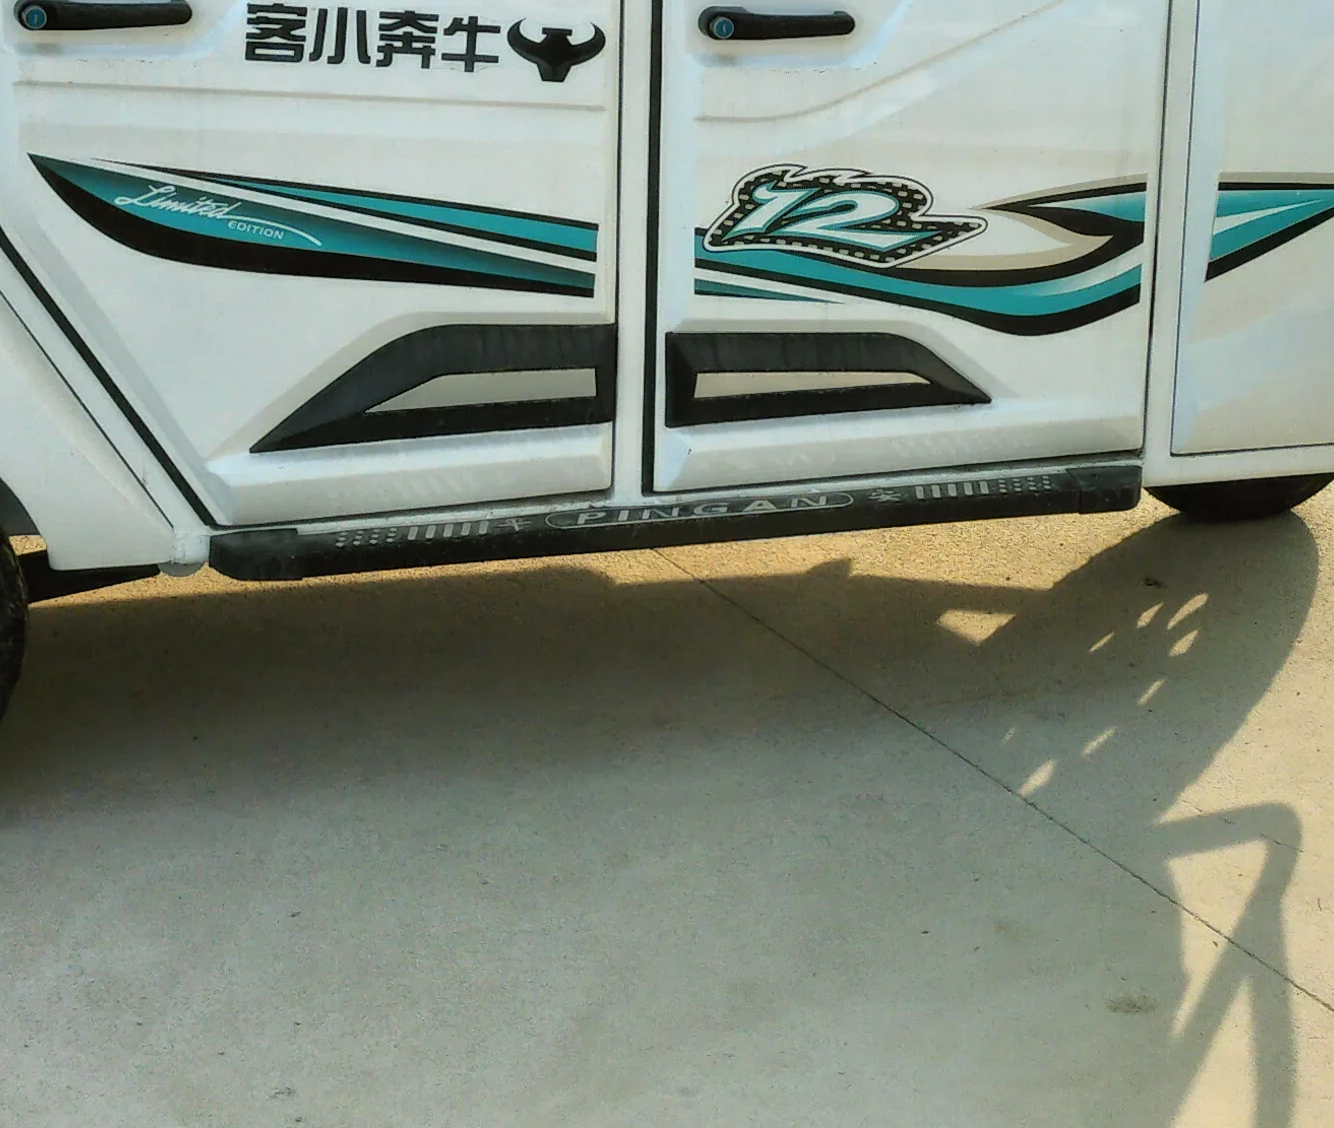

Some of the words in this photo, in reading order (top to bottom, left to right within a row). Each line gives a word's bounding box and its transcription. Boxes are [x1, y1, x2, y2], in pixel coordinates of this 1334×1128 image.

[245, 2, 502, 73] 客小奔牛
[114, 184, 243, 220] Limited
[228, 220, 285, 241] EDITION
[576, 495, 827, 526] PINGAN
